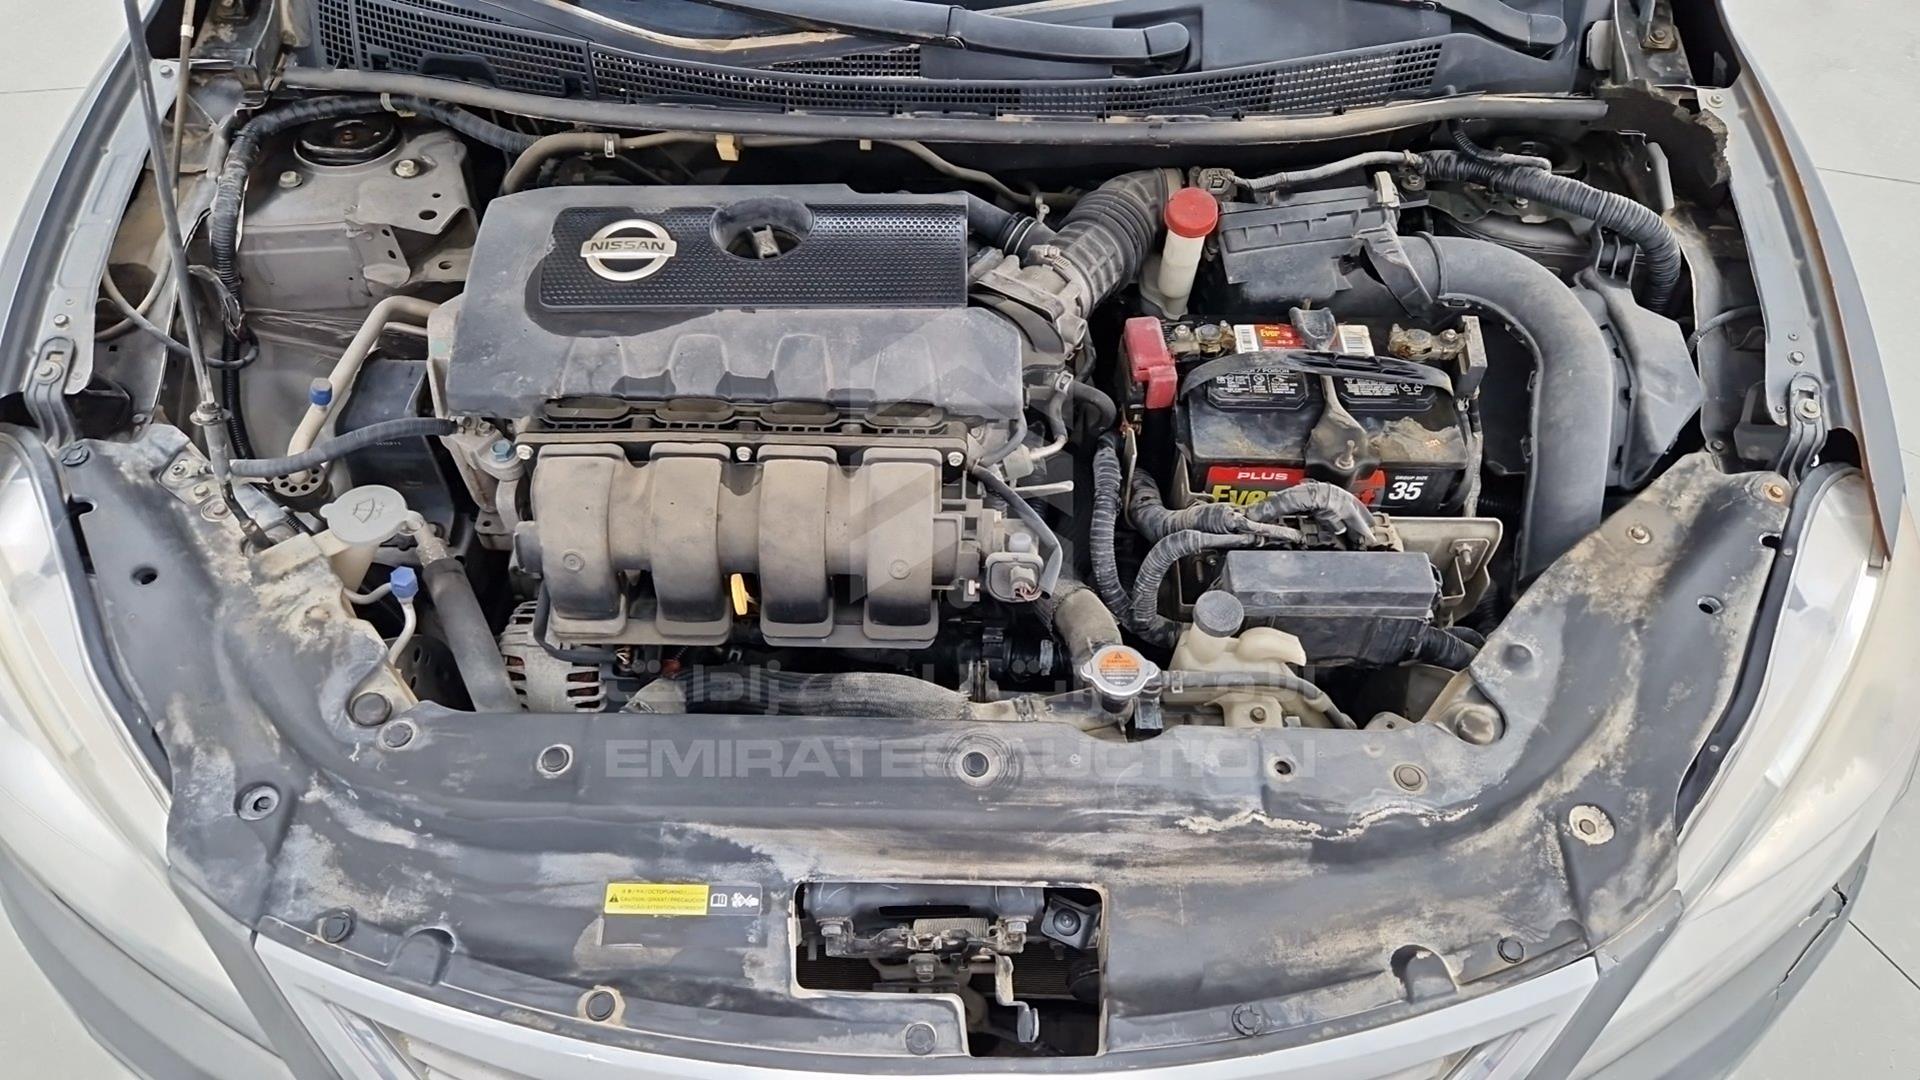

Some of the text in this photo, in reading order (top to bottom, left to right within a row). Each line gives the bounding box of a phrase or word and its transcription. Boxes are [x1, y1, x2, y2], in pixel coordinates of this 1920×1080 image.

[590, 241, 665, 251] NISSAN
[1236, 471, 1289, 481] PLUS
[1388, 482, 1424, 500] 35
